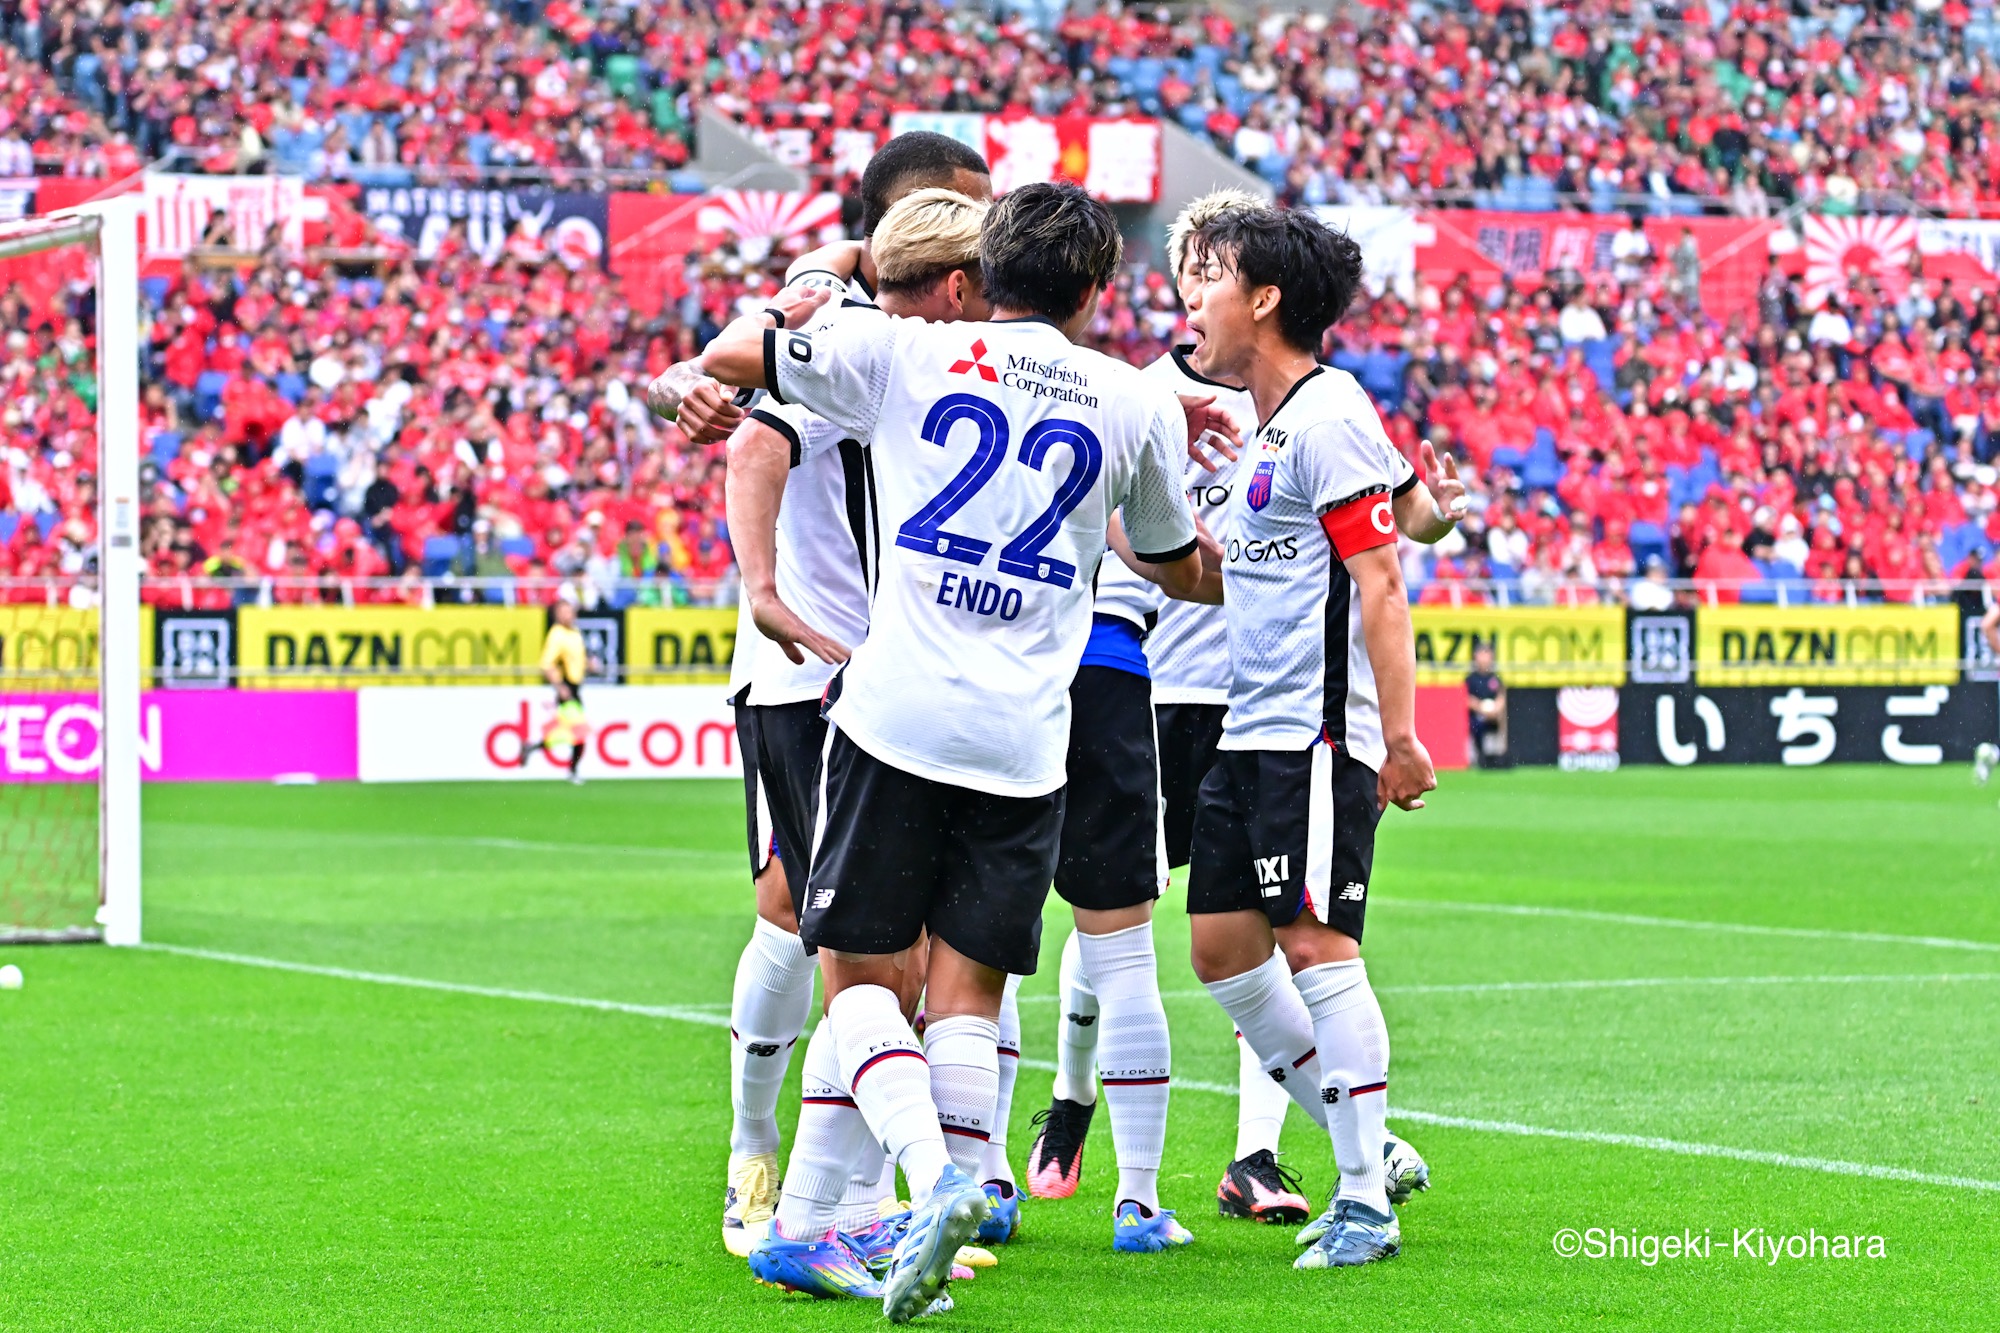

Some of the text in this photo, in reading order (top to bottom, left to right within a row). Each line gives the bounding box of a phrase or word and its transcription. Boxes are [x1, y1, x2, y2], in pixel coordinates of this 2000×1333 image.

[366, 188, 504, 217] MATHEUS
[1006, 353, 1088, 388] Mitsubishi
[1003, 372, 1098, 409] Corporation
[895, 392, 1103, 590] 22
[1370, 501, 1395, 535] C
[1244, 536, 1298, 563] GAS
[936, 571, 1023, 622] ENDO
[266, 630, 403, 673] DAZN
[1720, 627, 1837, 668] DAZN
[1656, 685, 1949, 766] いちご
[1120, 1068, 1167, 1076] TOKYO
